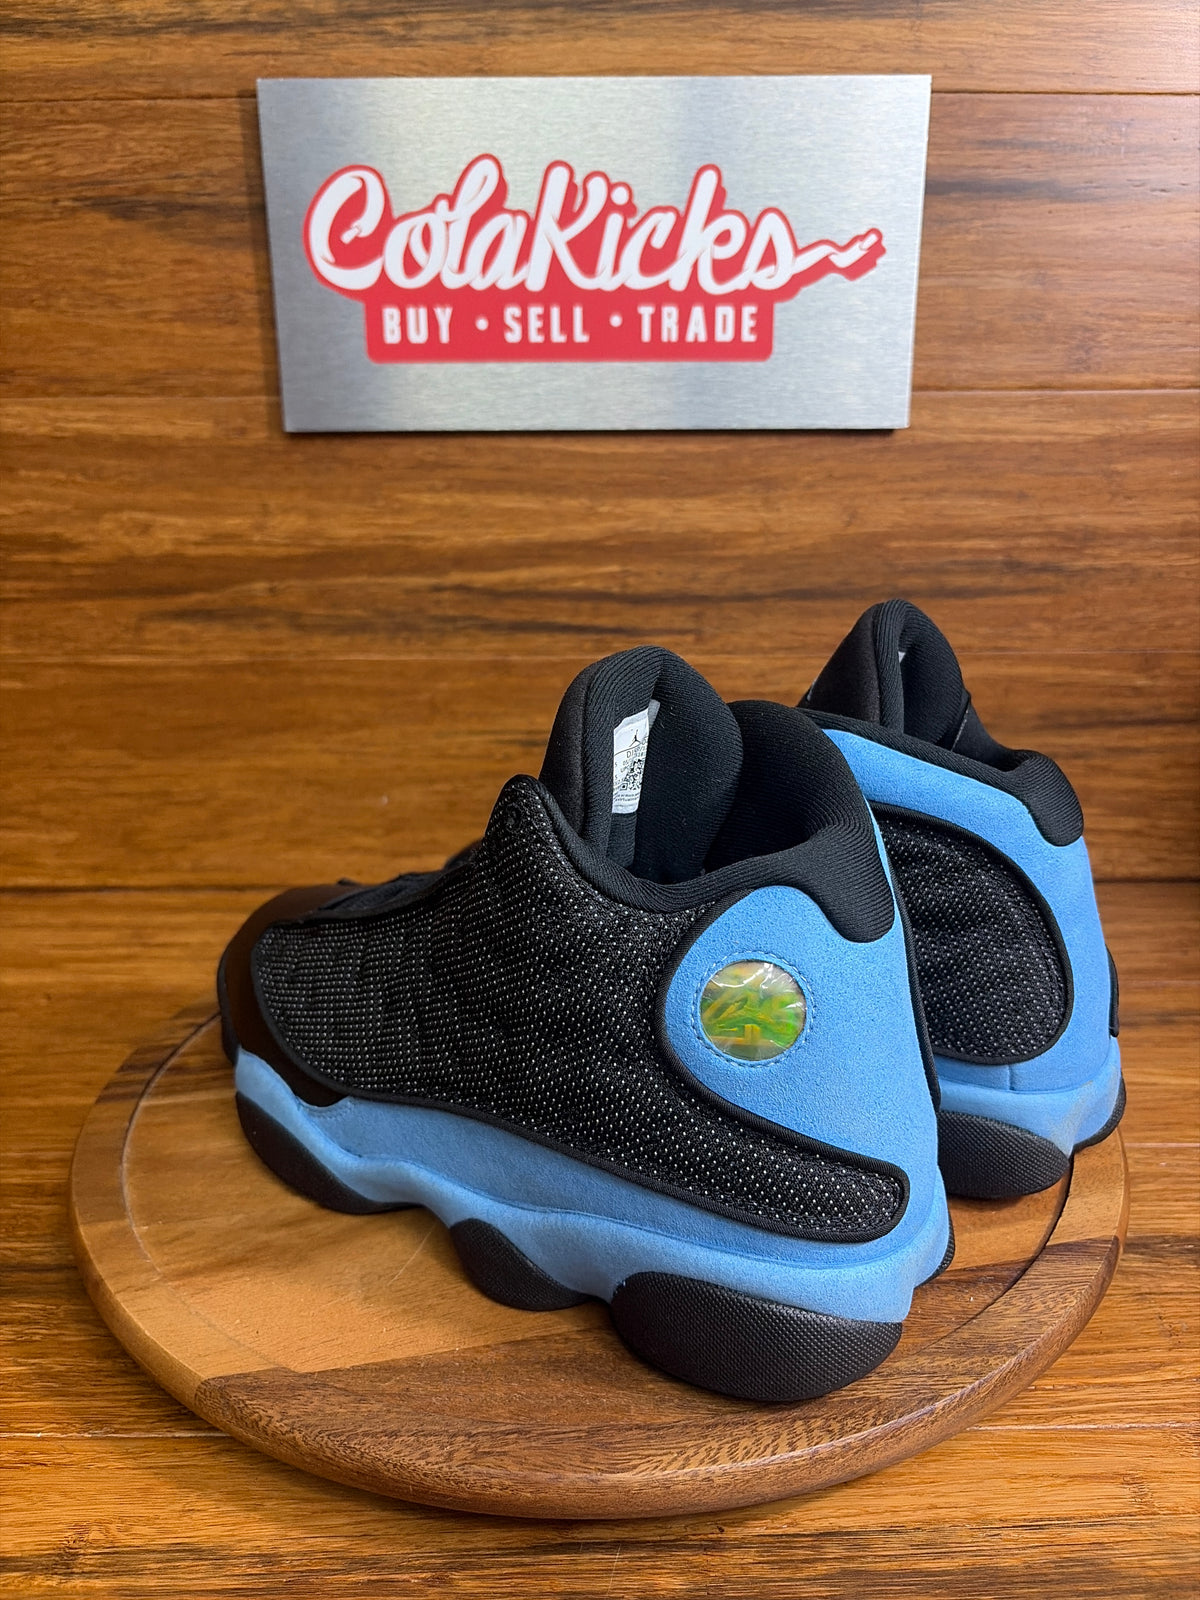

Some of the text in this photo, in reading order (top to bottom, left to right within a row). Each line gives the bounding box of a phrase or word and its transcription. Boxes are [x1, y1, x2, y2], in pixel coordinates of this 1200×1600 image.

[383, 305, 758, 345] BUY SELL TRADE
